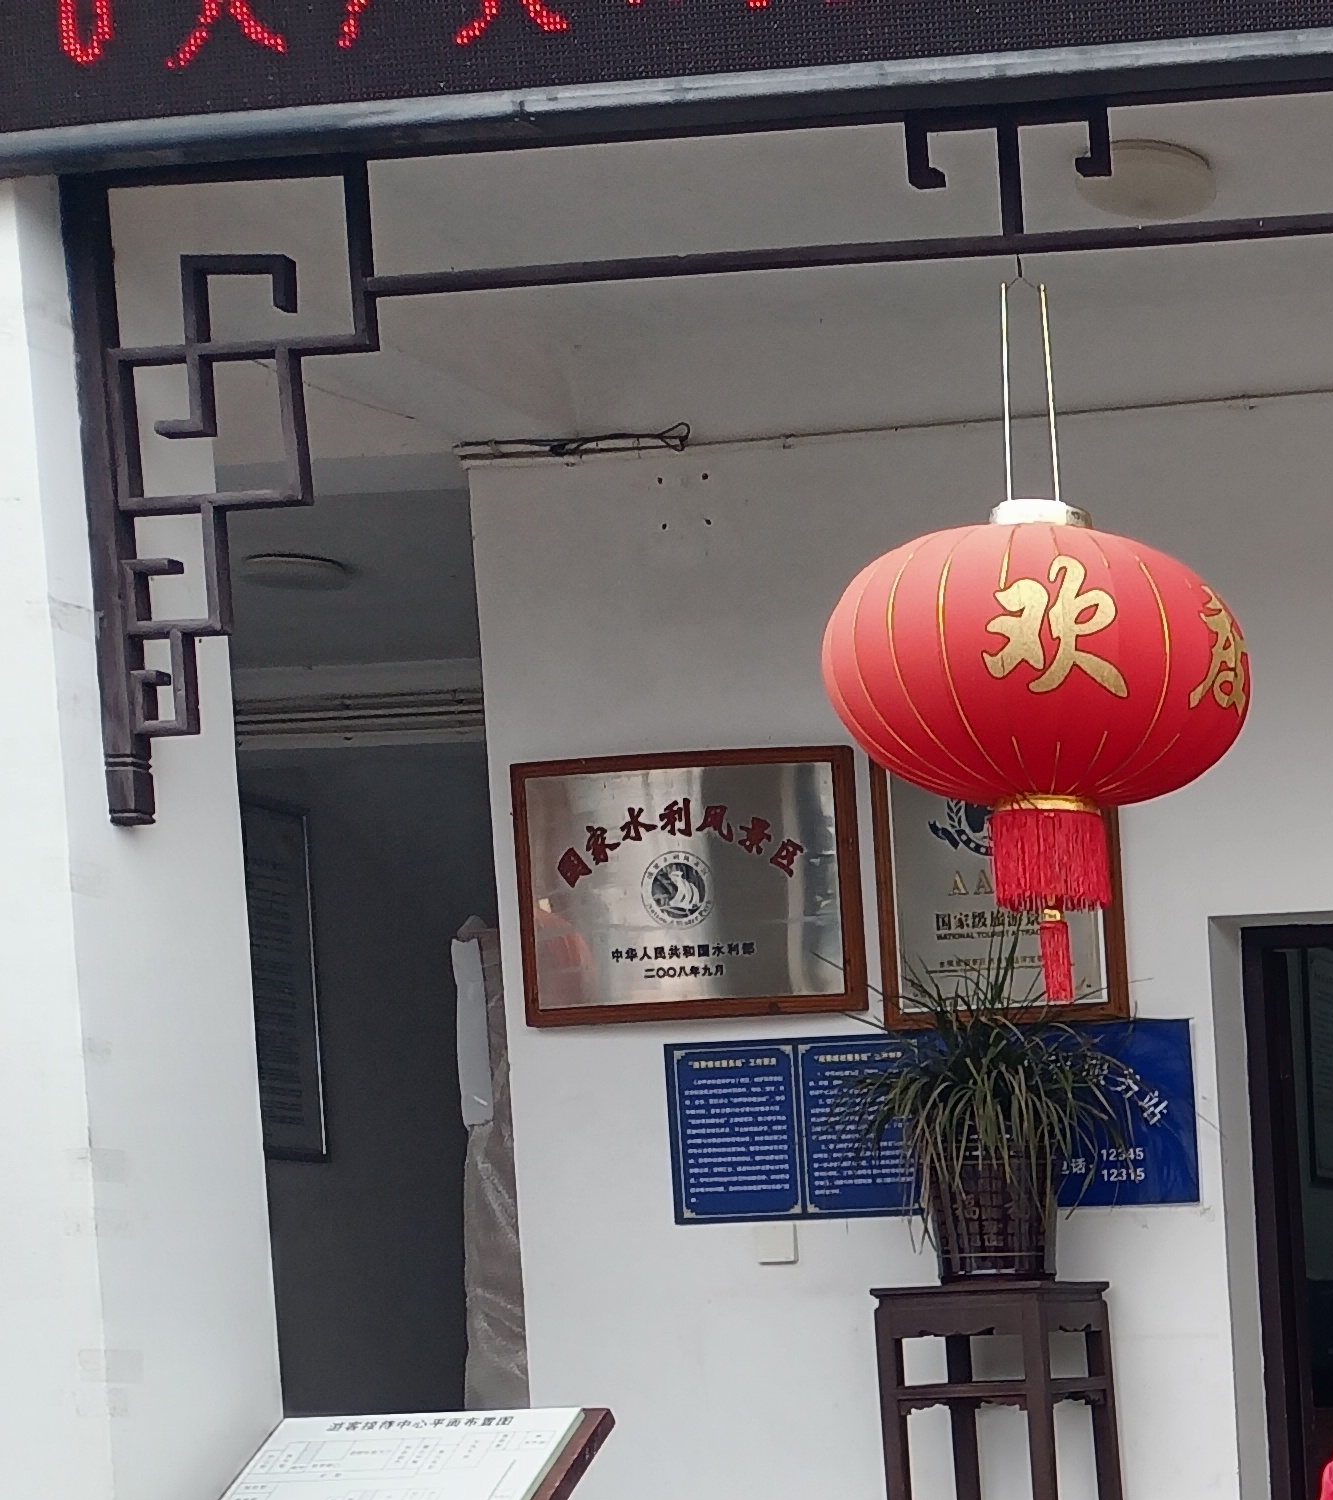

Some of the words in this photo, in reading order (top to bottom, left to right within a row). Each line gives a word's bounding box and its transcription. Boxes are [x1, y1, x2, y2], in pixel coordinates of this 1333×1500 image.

[982, 555, 1129, 698] 欢
[611, 941, 755, 963] 中华人民共和国水利部
[1101, 1148, 1144, 1161] 12345
[1101, 1168, 1145, 1182] 12315
